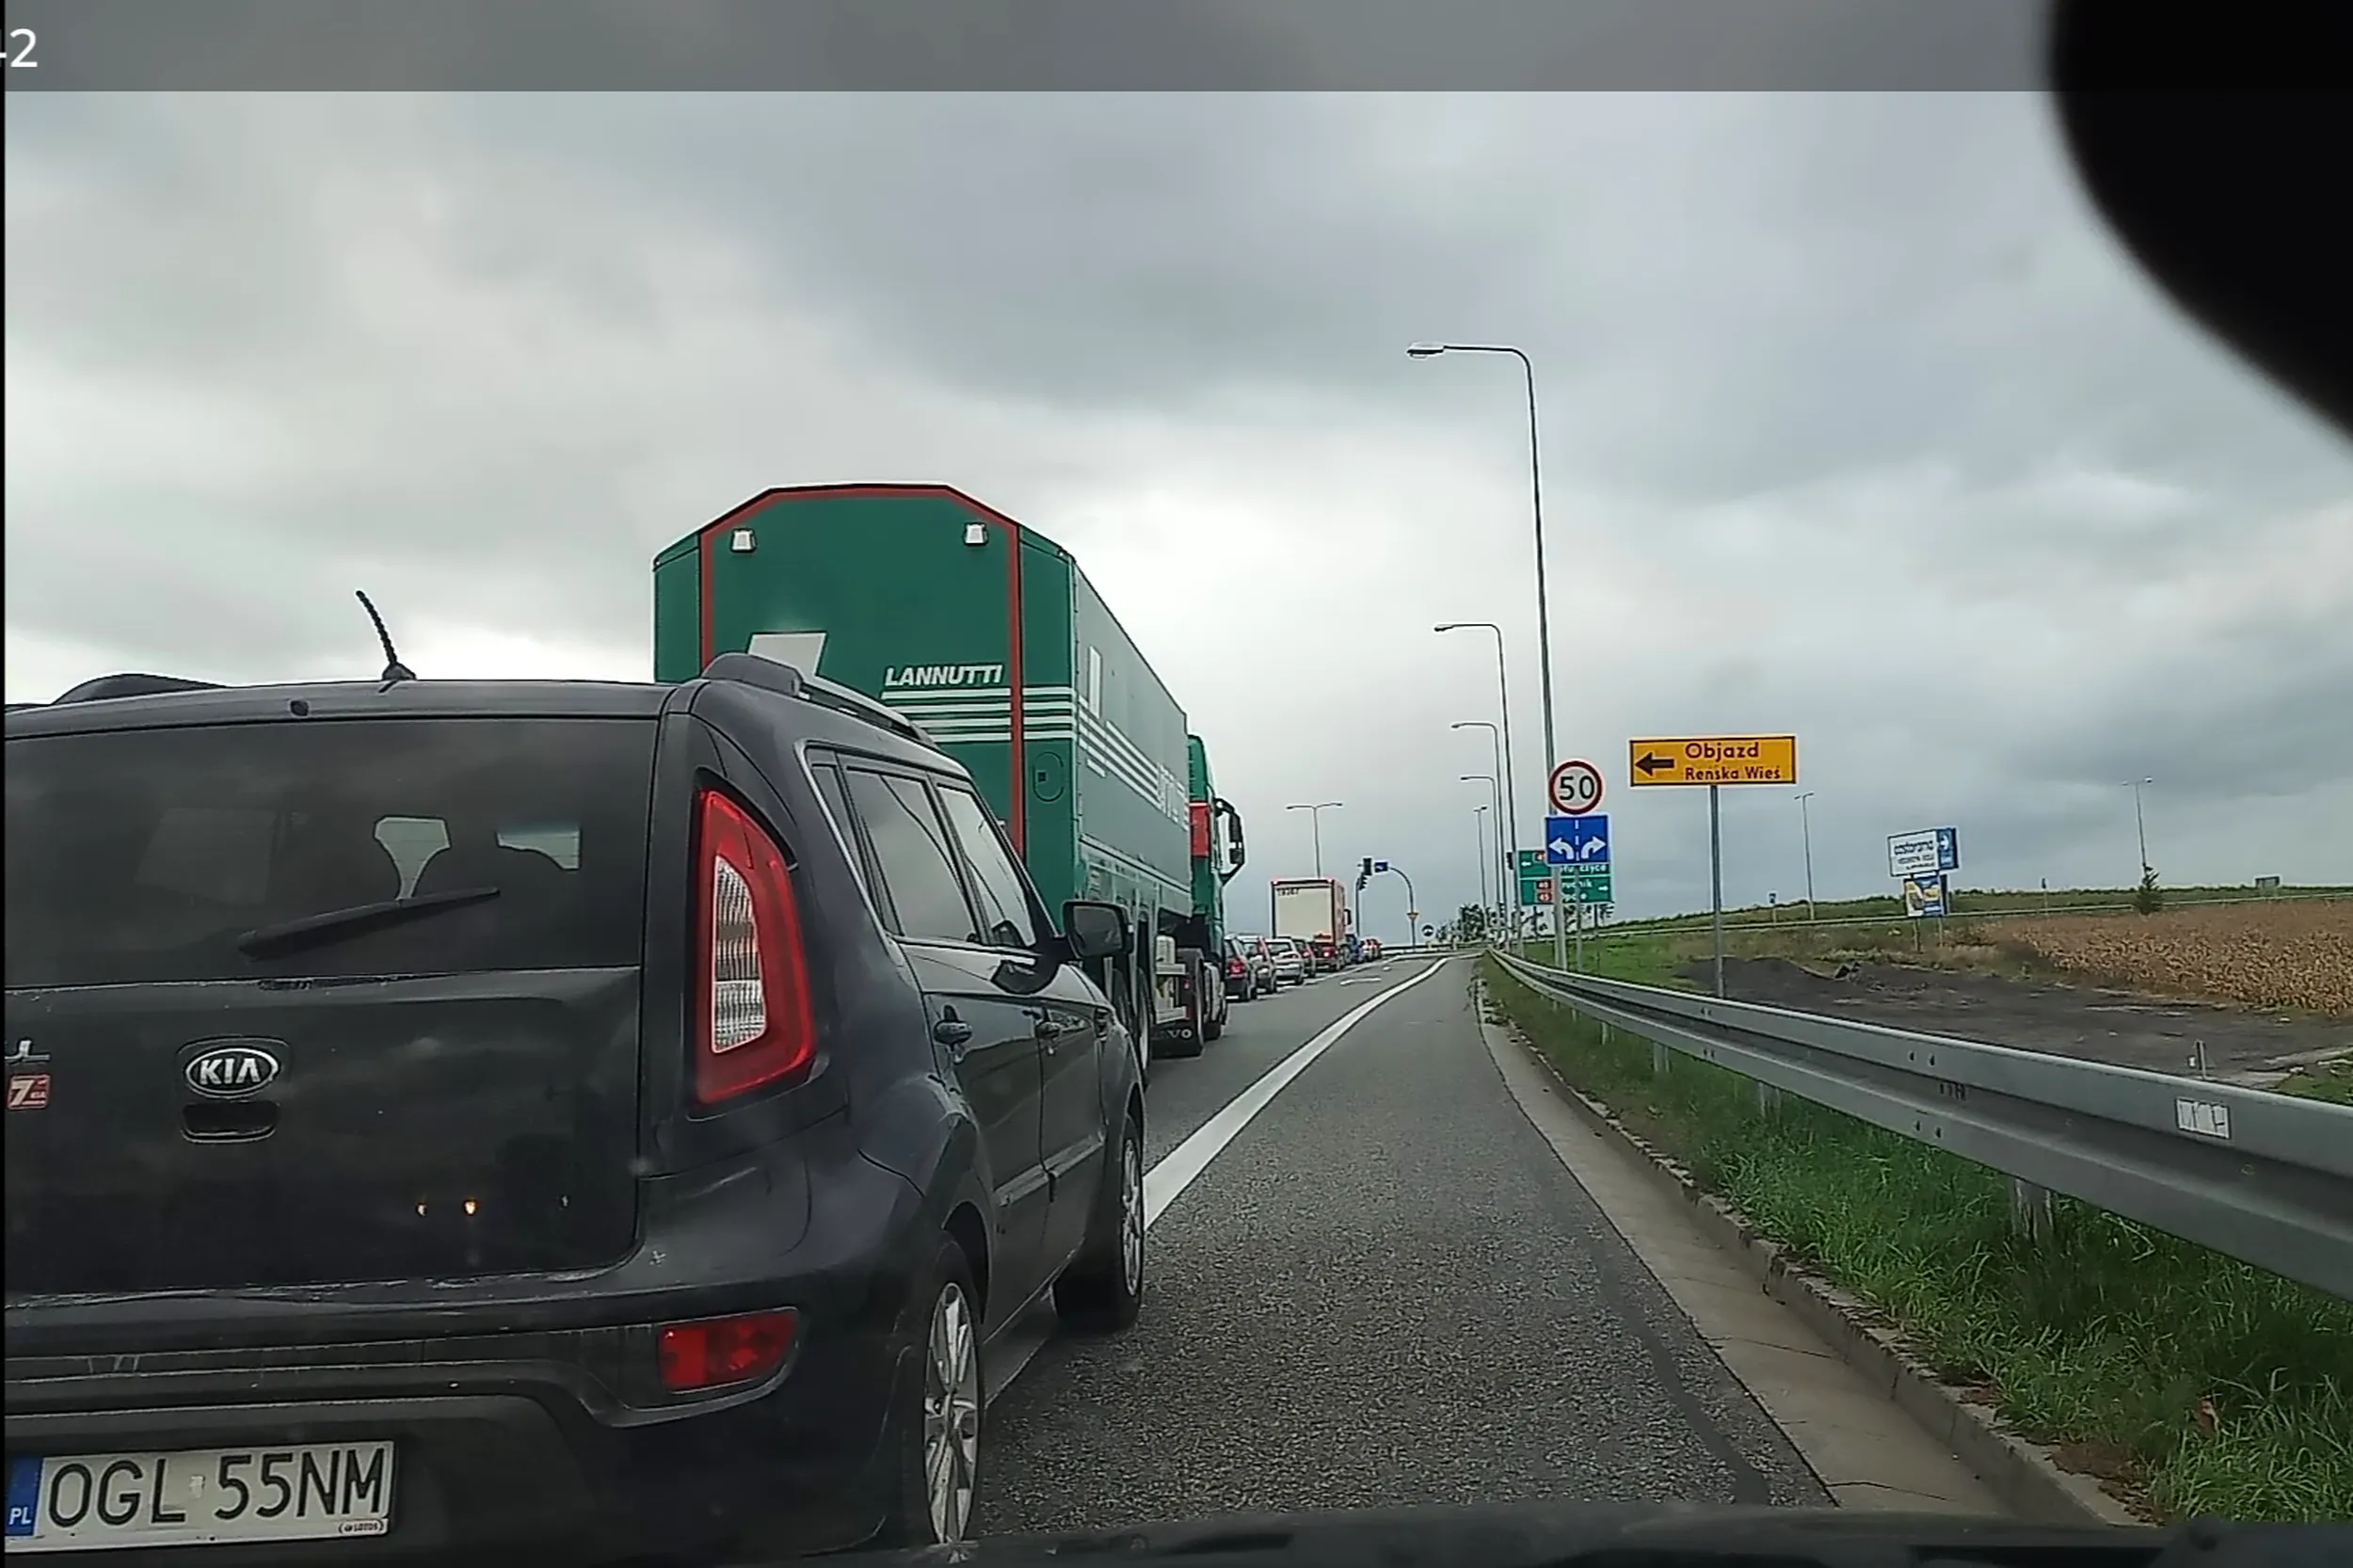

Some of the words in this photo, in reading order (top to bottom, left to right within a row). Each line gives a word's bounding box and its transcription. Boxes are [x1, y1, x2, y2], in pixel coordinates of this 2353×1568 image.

[885, 664, 1002, 686] LANNUTTI
[1685, 742, 1759, 762] Objazd
[1559, 775, 1595, 801] 50
[200, 1057, 261, 1085] KIA
[48, 1458, 187, 1528] OGL
[215, 1448, 385, 1520] 55NM
[8, 1506, 32, 1525] PL
